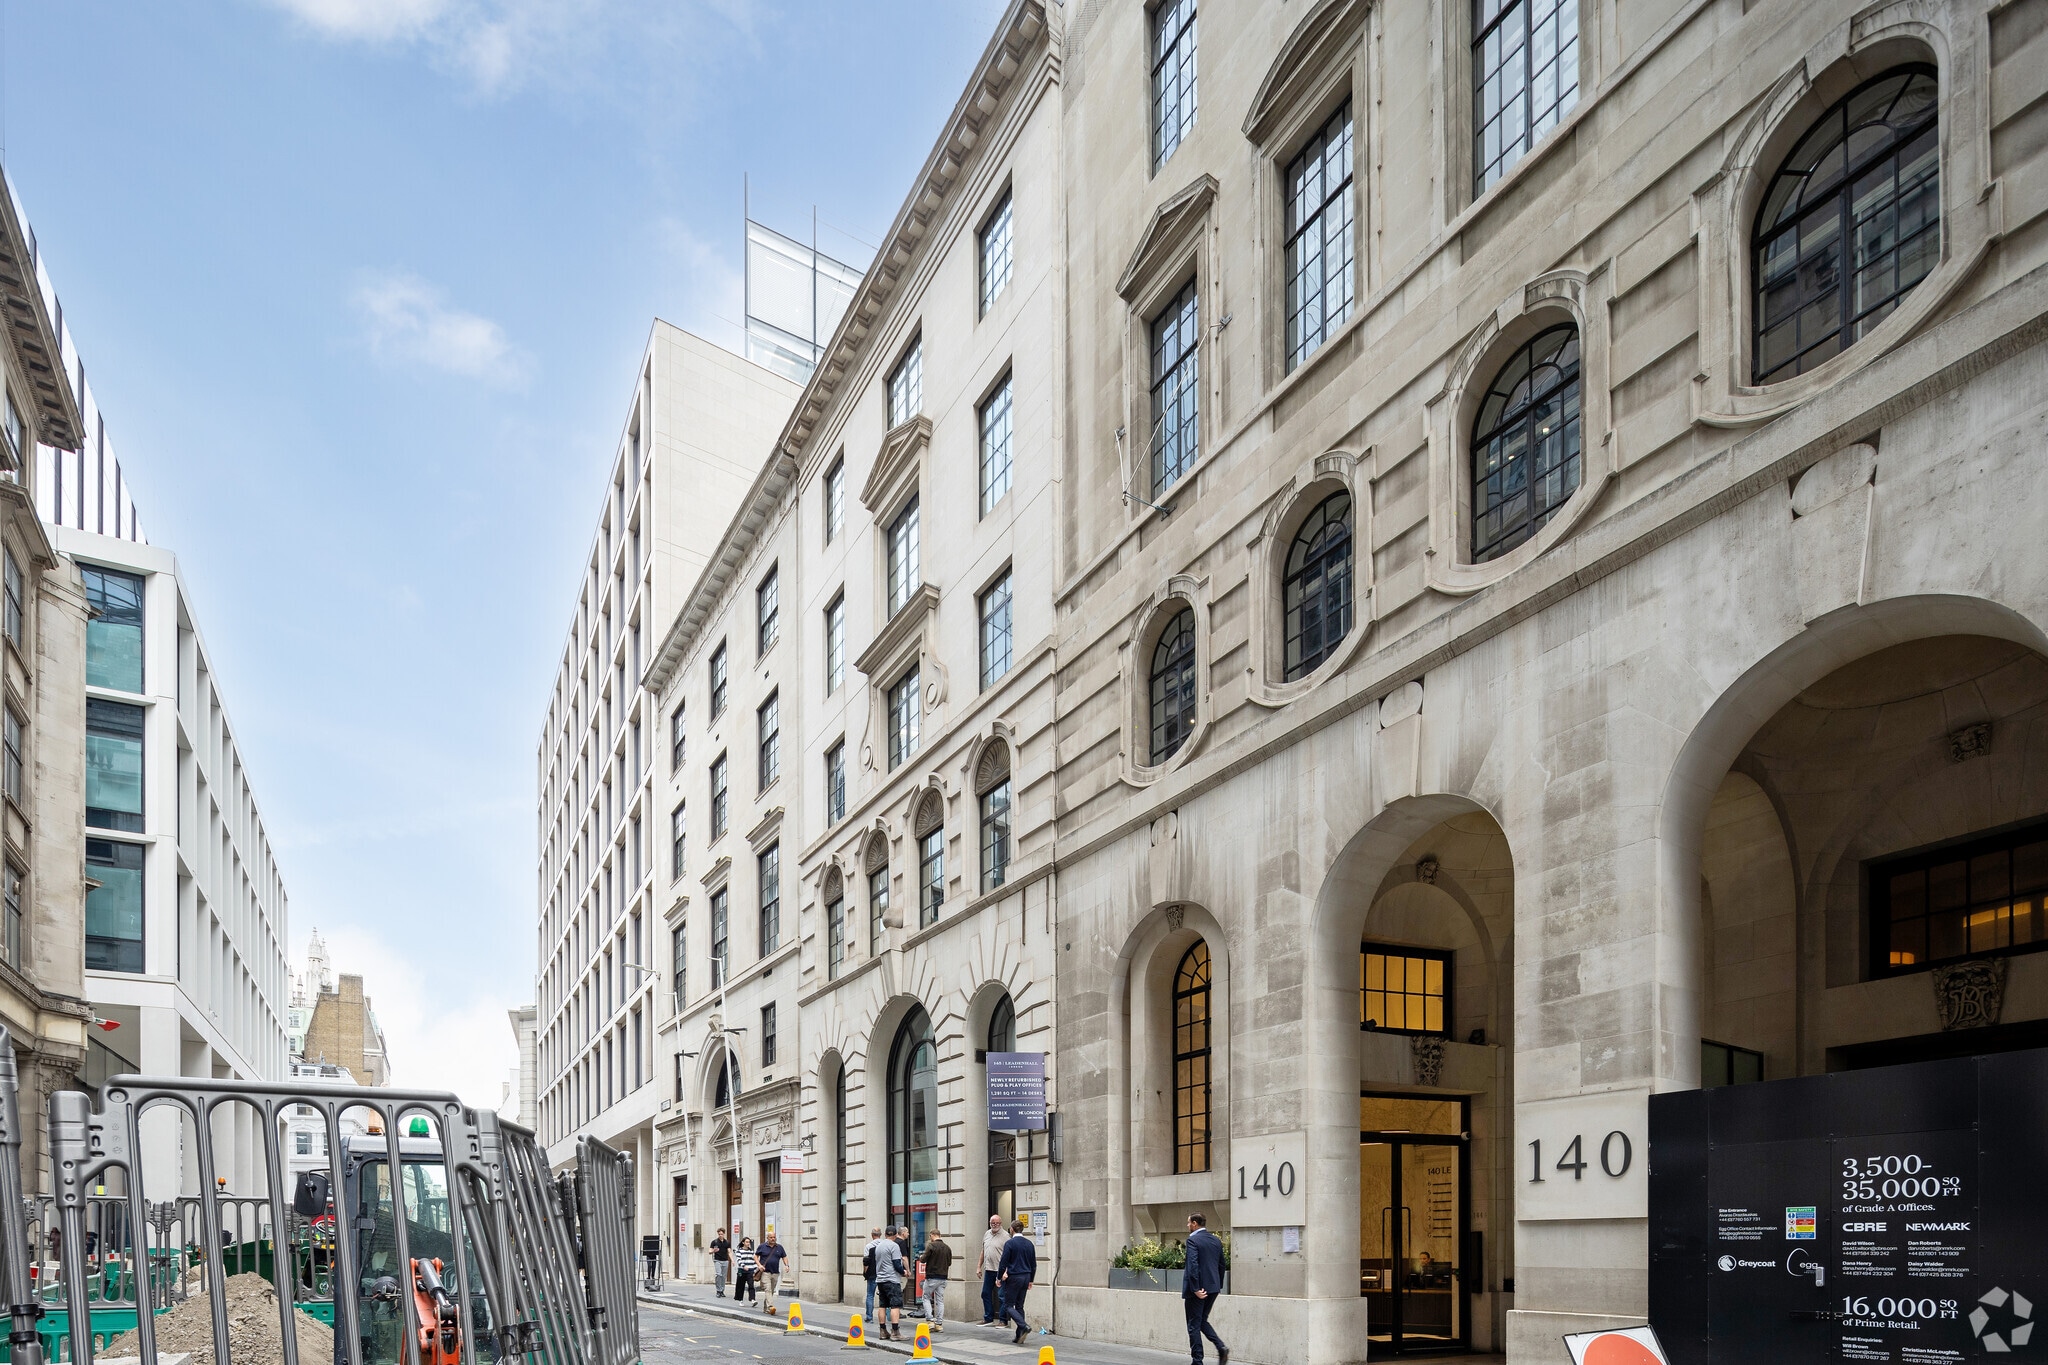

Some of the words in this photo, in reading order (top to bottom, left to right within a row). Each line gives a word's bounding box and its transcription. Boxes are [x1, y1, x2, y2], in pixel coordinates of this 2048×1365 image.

[1529, 1131, 1632, 1182] 140
[1237, 1161, 1295, 1199] 140
[1842, 1177, 1940, 1202] 35,000
[1942, 1176, 1960, 1187] SQ
[1942, 1187, 1961, 1197] FT
[1024, 1191, 1039, 1202] 145
[1842, 1205, 1853, 1213] of
[1855, 1204, 1884, 1213] Grade
[1886, 1204, 1895, 1212] A
[1897, 1203, 1936, 1211] Offices.
[1842, 1222, 1887, 1232] CBRE
[1905, 1222, 1971, 1231] NEWMARK
[1738, 1260, 1776, 1268] Greycoat
[1842, 1296, 1936, 1319] 16,000
[1939, 1299, 1957, 1310] SQ
[1940, 1310, 1958, 1319] FT
[1855, 1319, 1885, 1328] Prime
[1888, 1320, 1920, 1330] Retail.
